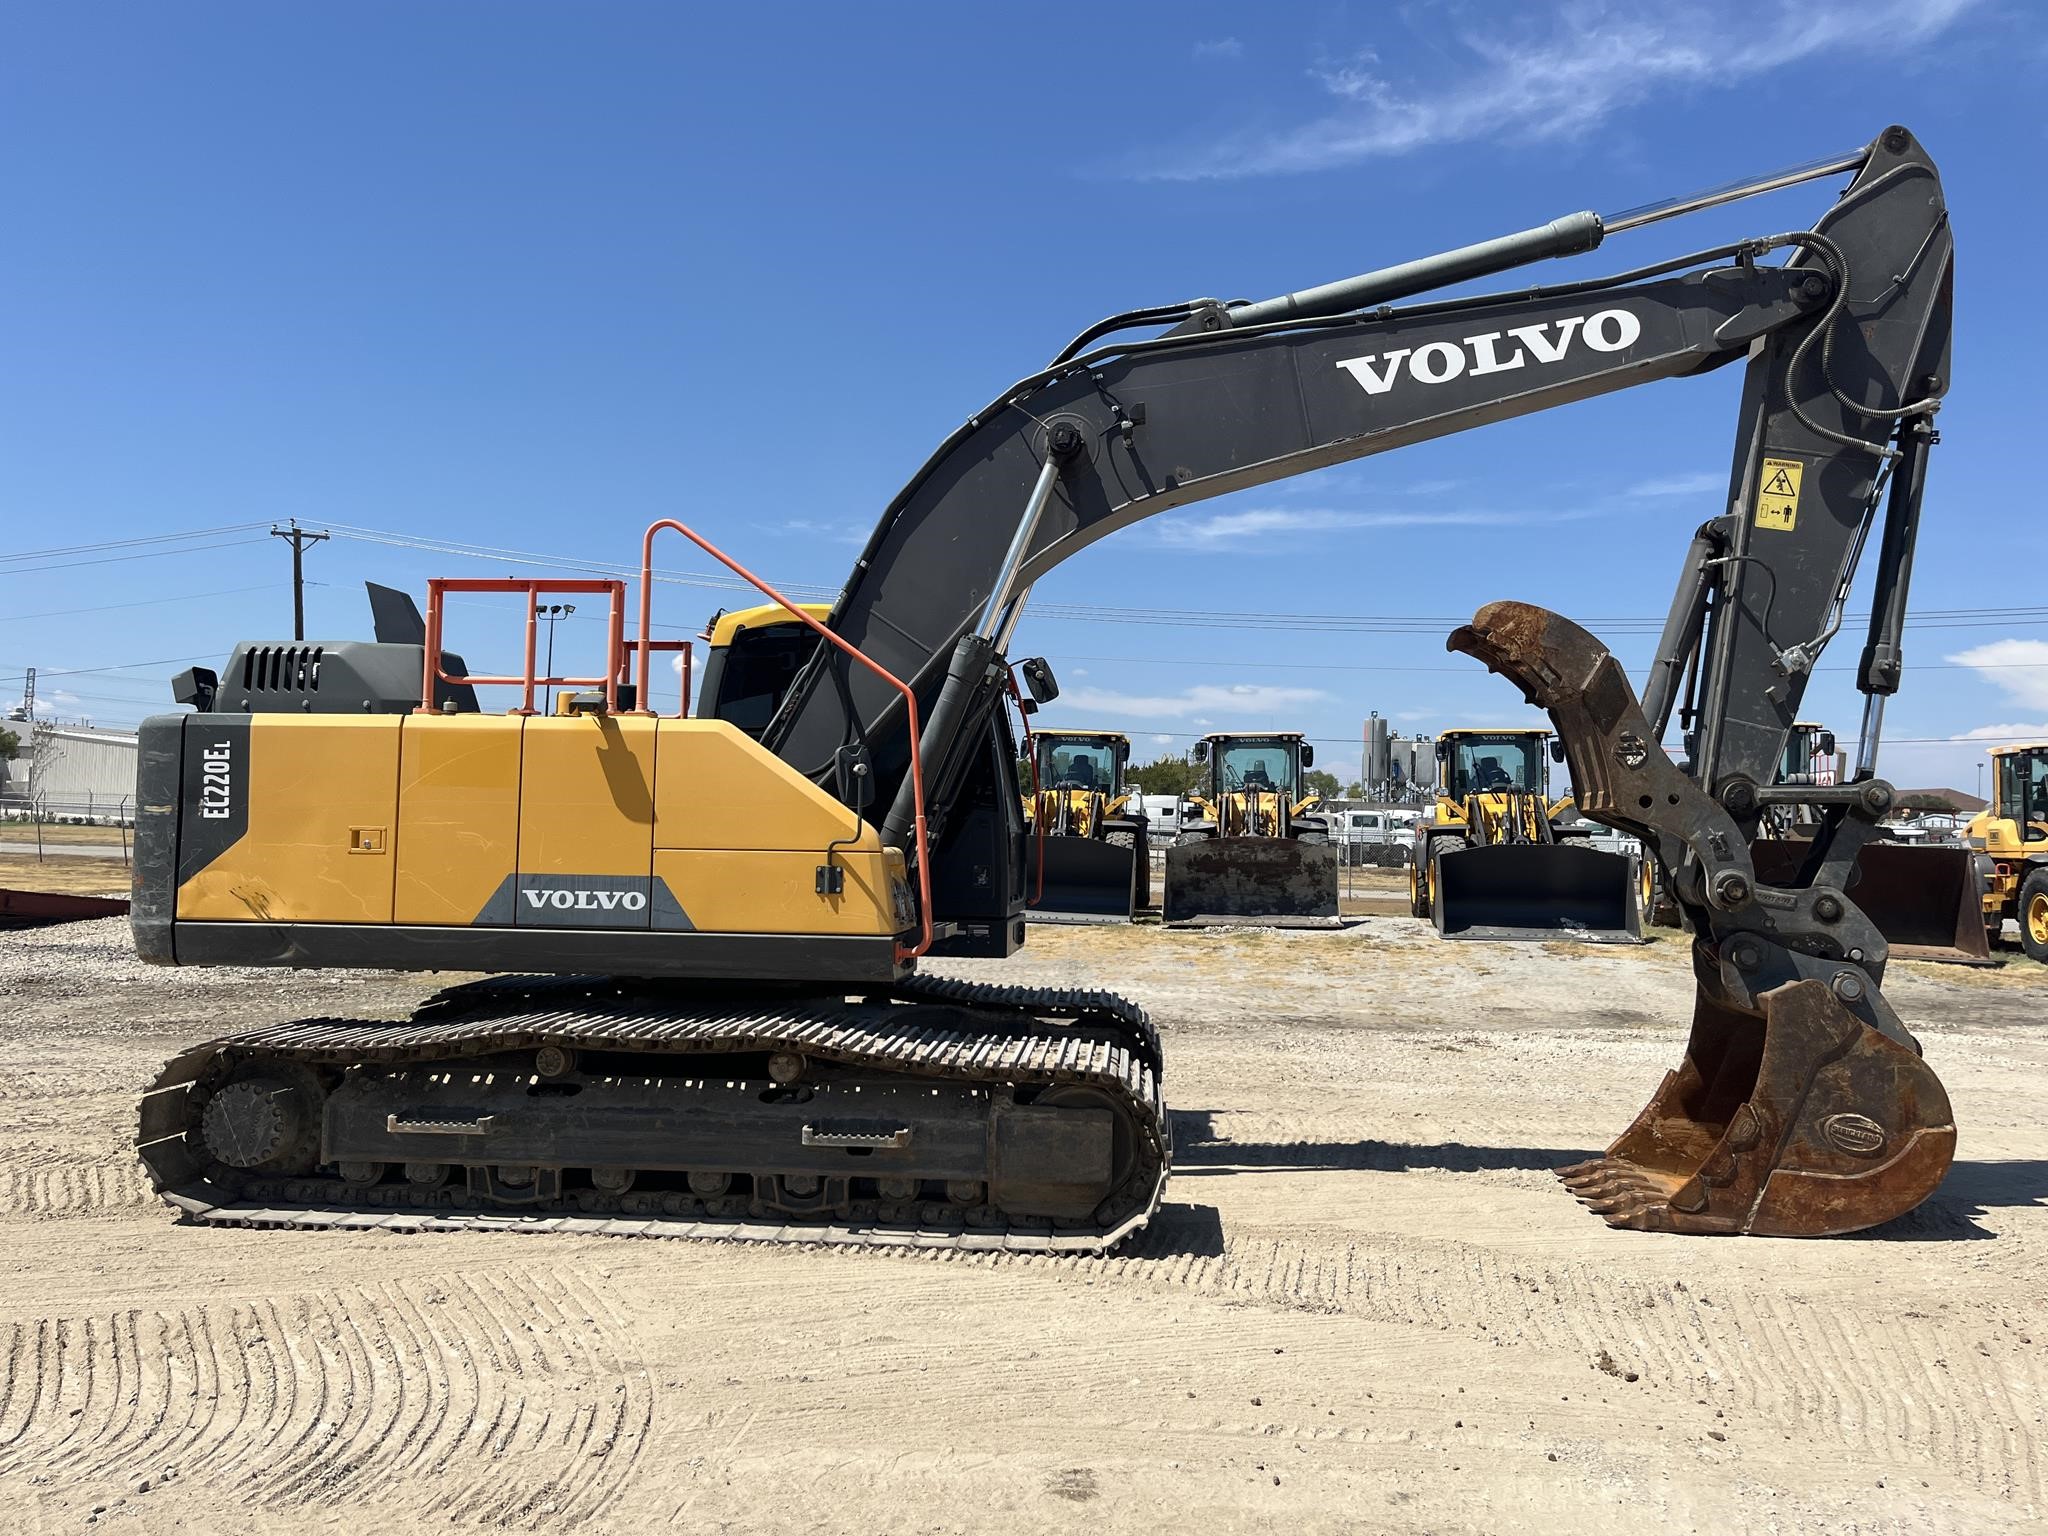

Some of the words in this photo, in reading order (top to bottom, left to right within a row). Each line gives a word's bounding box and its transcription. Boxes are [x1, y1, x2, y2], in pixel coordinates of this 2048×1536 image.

[1336, 309, 1641, 395] VOLVO
[1773, 461, 1800, 469] WARNING
[522, 889, 646, 911] VOLVO
